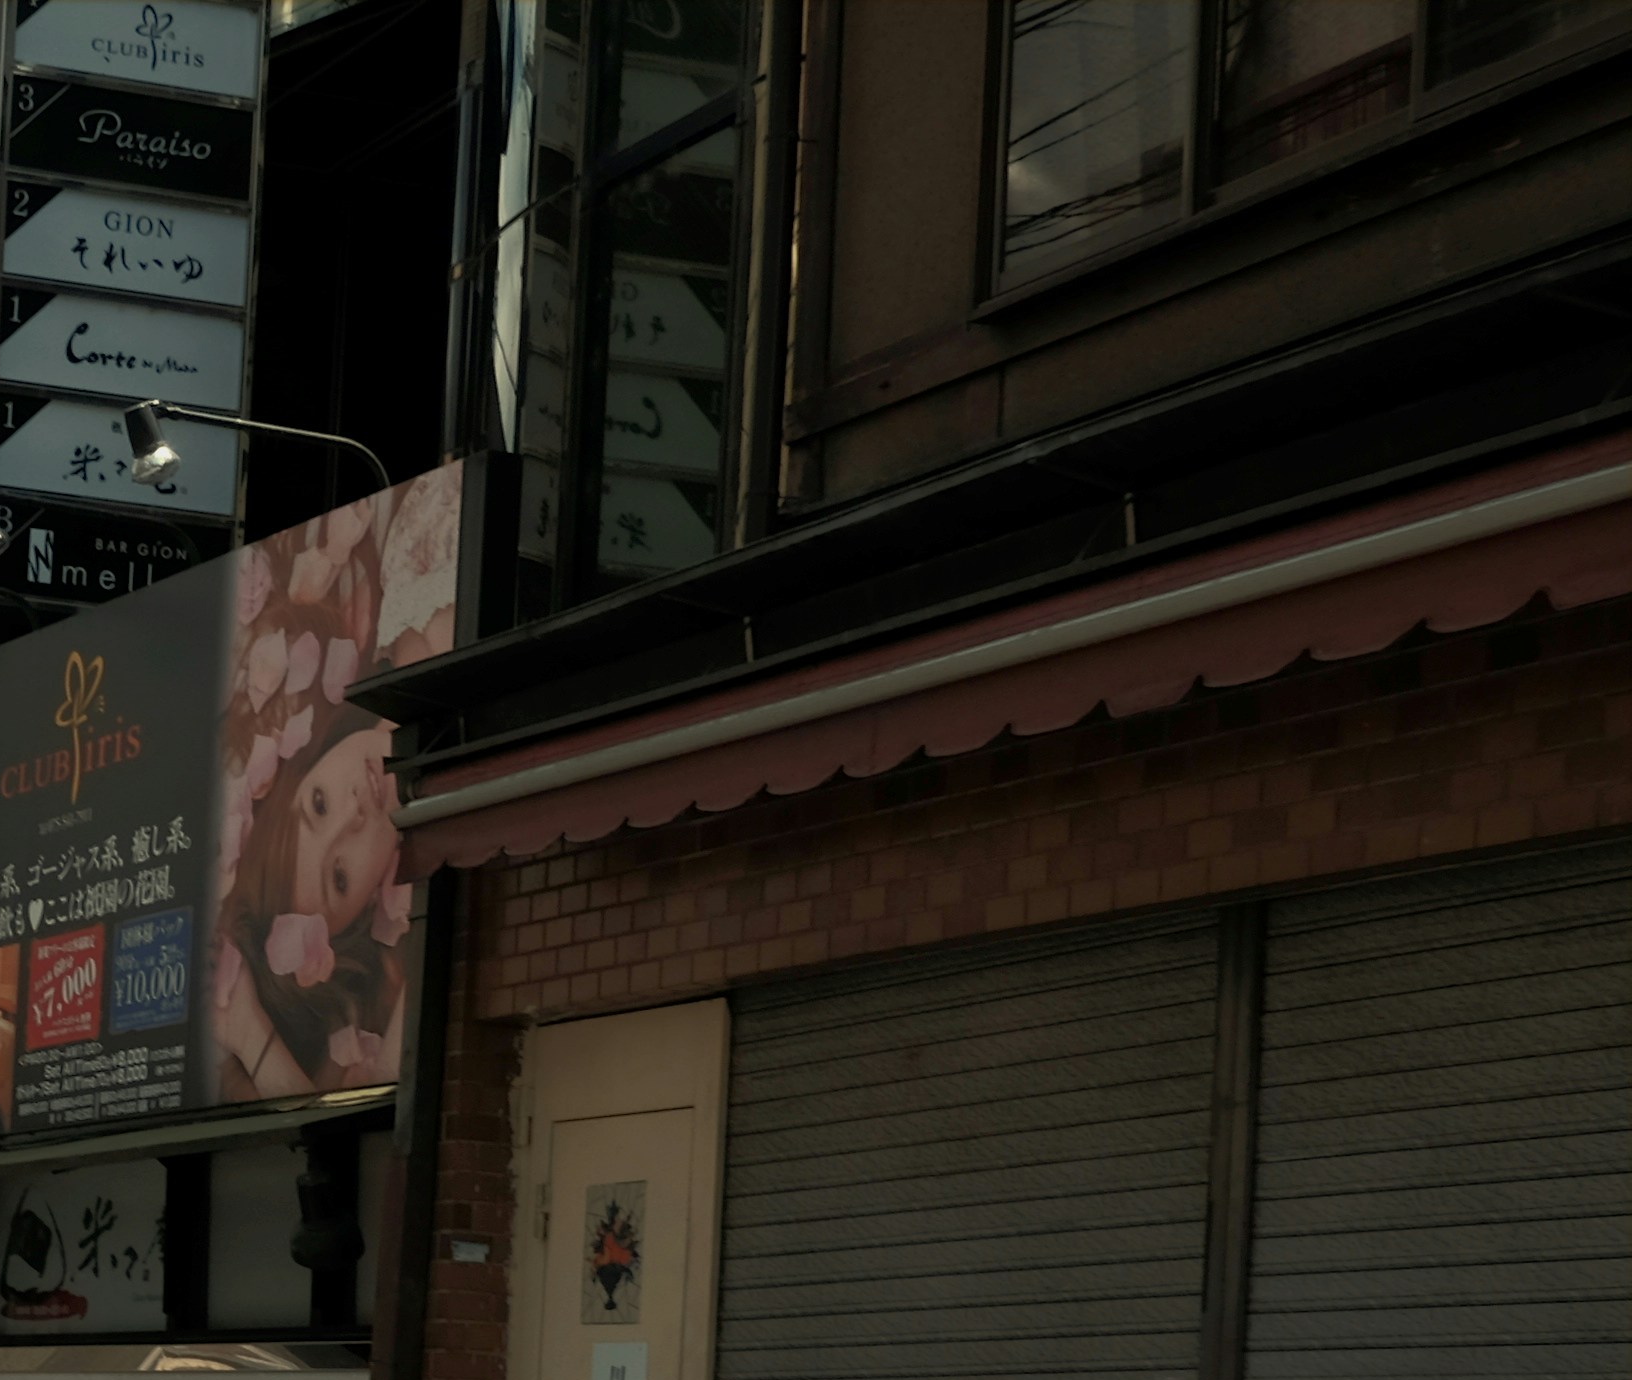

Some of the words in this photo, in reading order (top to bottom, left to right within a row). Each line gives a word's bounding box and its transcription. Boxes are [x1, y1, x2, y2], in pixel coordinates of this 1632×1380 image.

[91, 37, 148, 60] CLUB
[161, 41, 205, 68] iris
[18, 83, 35, 112] 3
[77, 108, 212, 160] Paraiso
[13, 188, 31, 217] 2
[104, 210, 174, 240] GION
[9, 294, 21, 324] 1
[2, 402, 15, 430] 1
[95, 536, 129, 554] BAR
[137, 542, 188, 562] GION
[62, 560, 153, 592] mell
[1, 751, 71, 799] CLUB
[83, 719, 142, 773] iris
